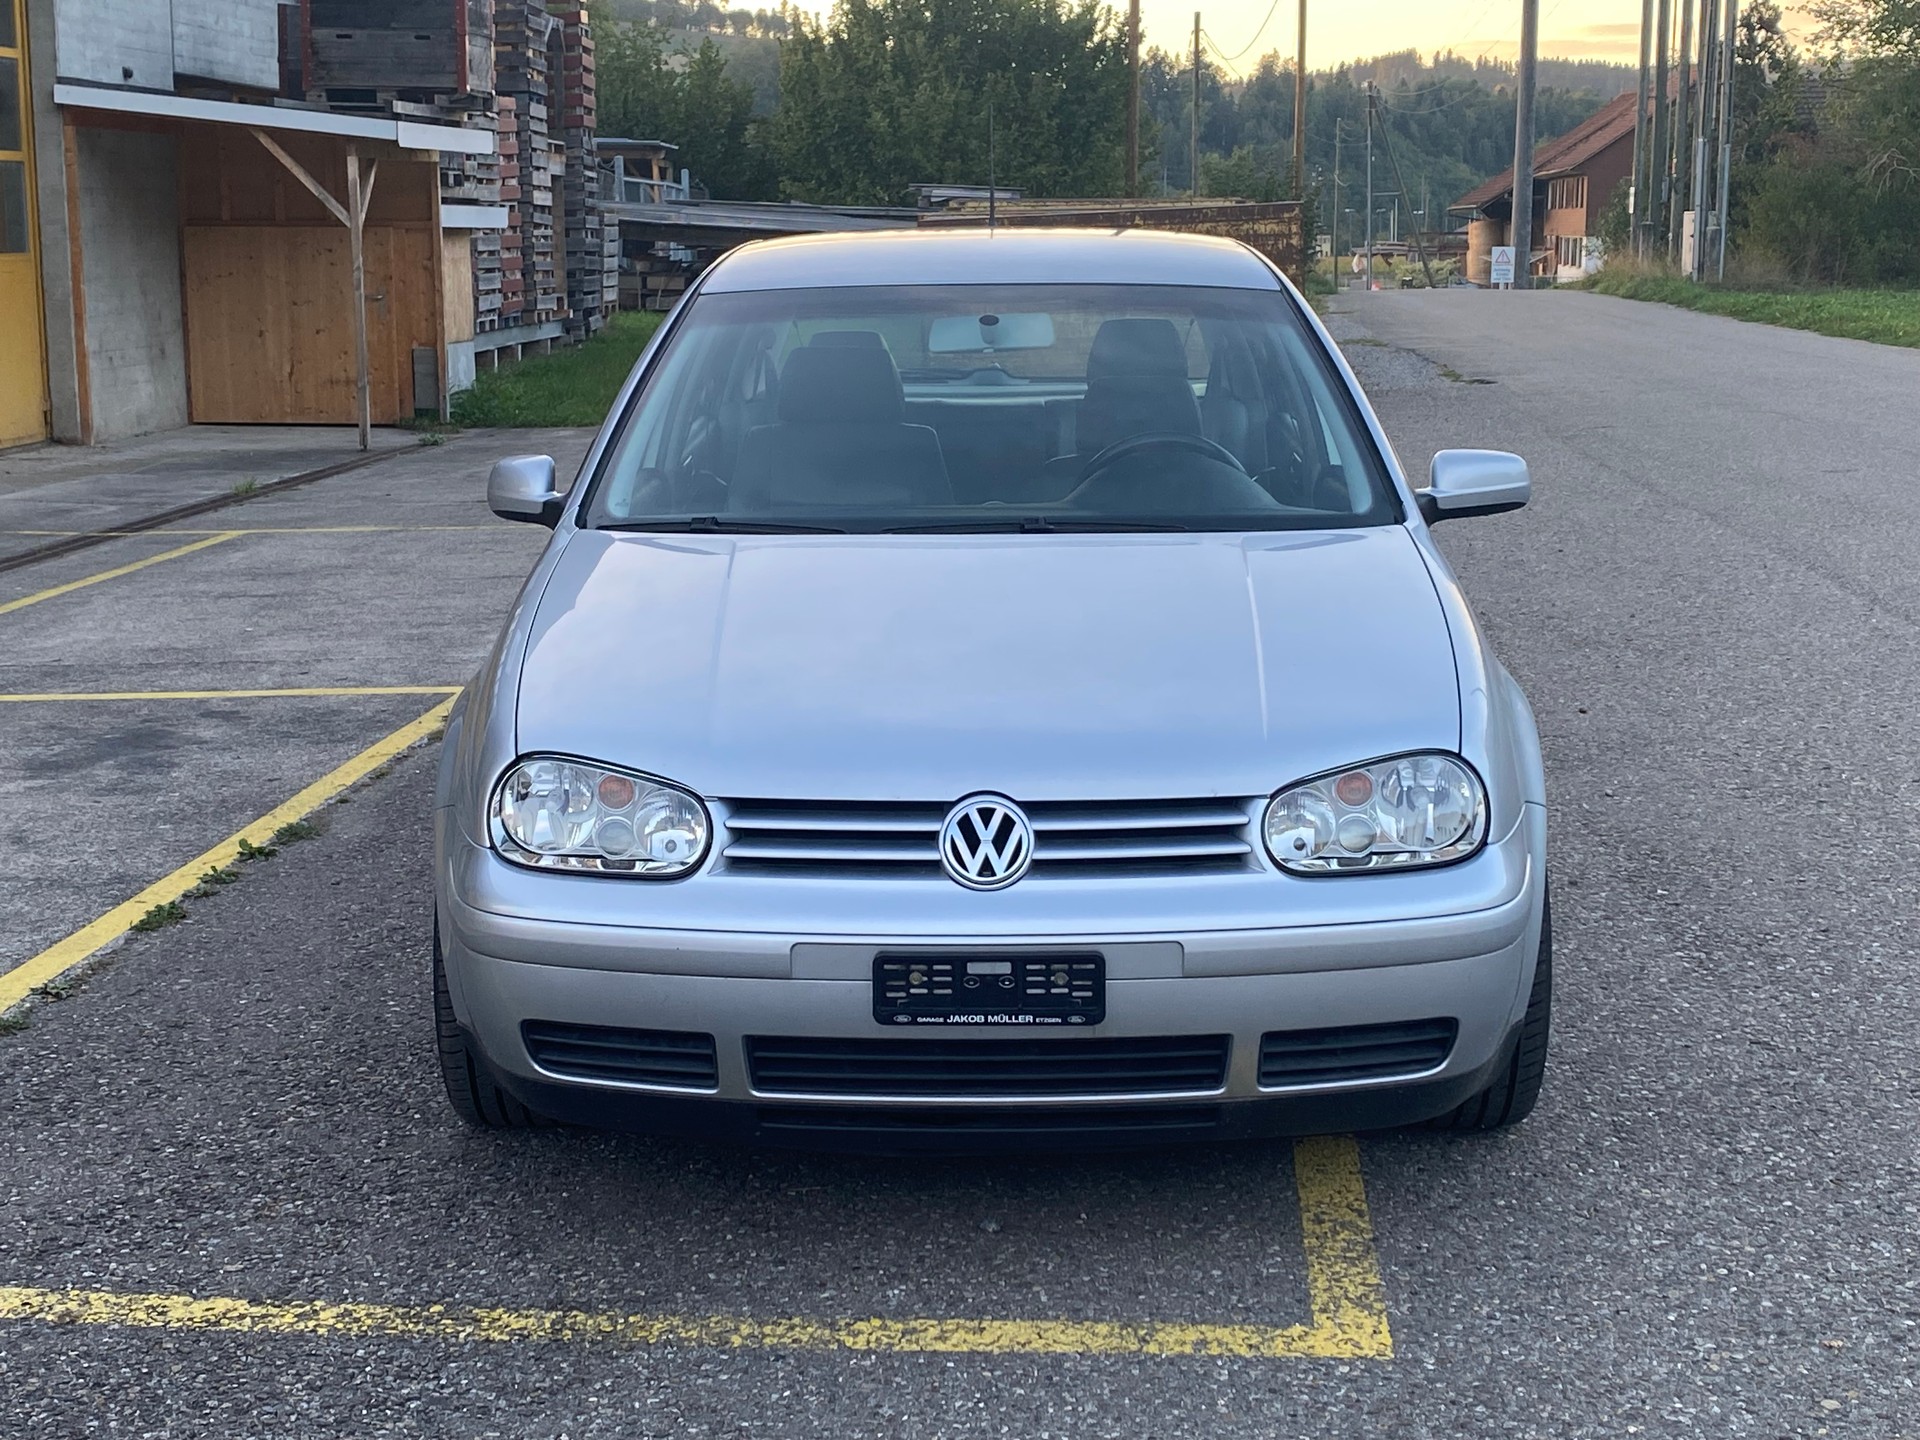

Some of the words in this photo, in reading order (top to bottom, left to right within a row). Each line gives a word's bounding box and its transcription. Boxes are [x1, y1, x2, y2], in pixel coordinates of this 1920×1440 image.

[943, 799, 1030, 885] VW
[946, 1014, 985, 1023] JAKOB
[987, 1013, 1034, 1024] MÜLLER
